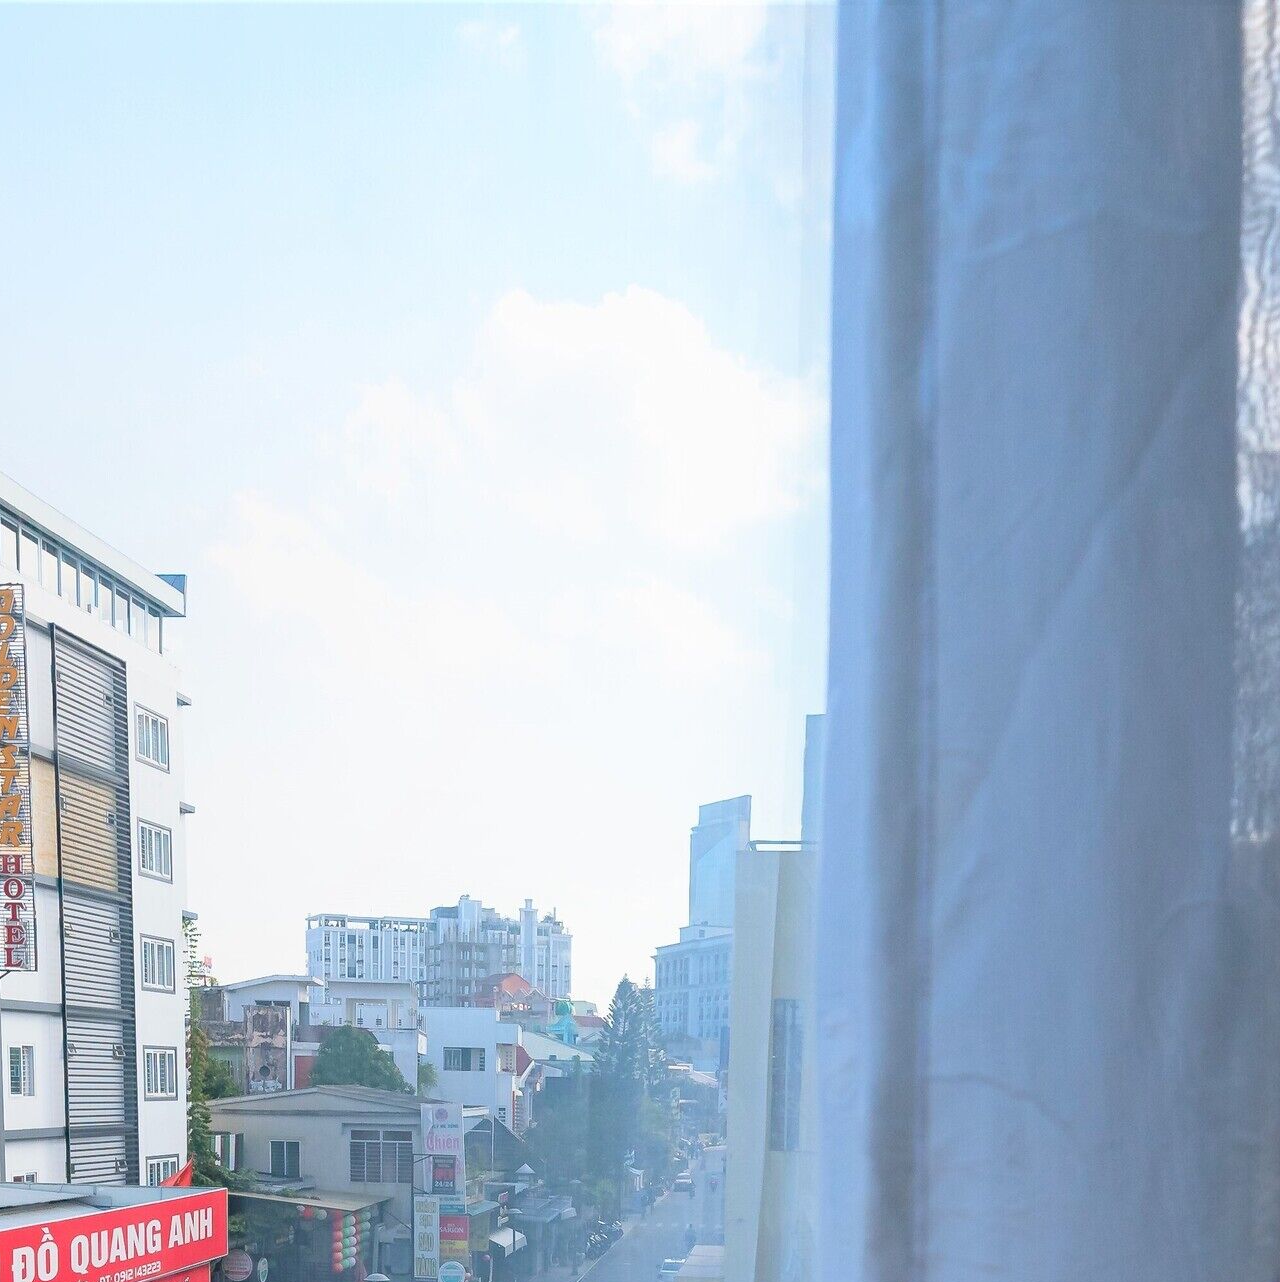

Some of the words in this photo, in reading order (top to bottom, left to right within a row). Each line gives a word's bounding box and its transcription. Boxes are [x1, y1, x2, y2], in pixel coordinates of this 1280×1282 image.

[0, 855, 26, 968] HOTEL
[70, 1219, 162, 1273] QUANG
[168, 1207, 213, 1245] ANH
